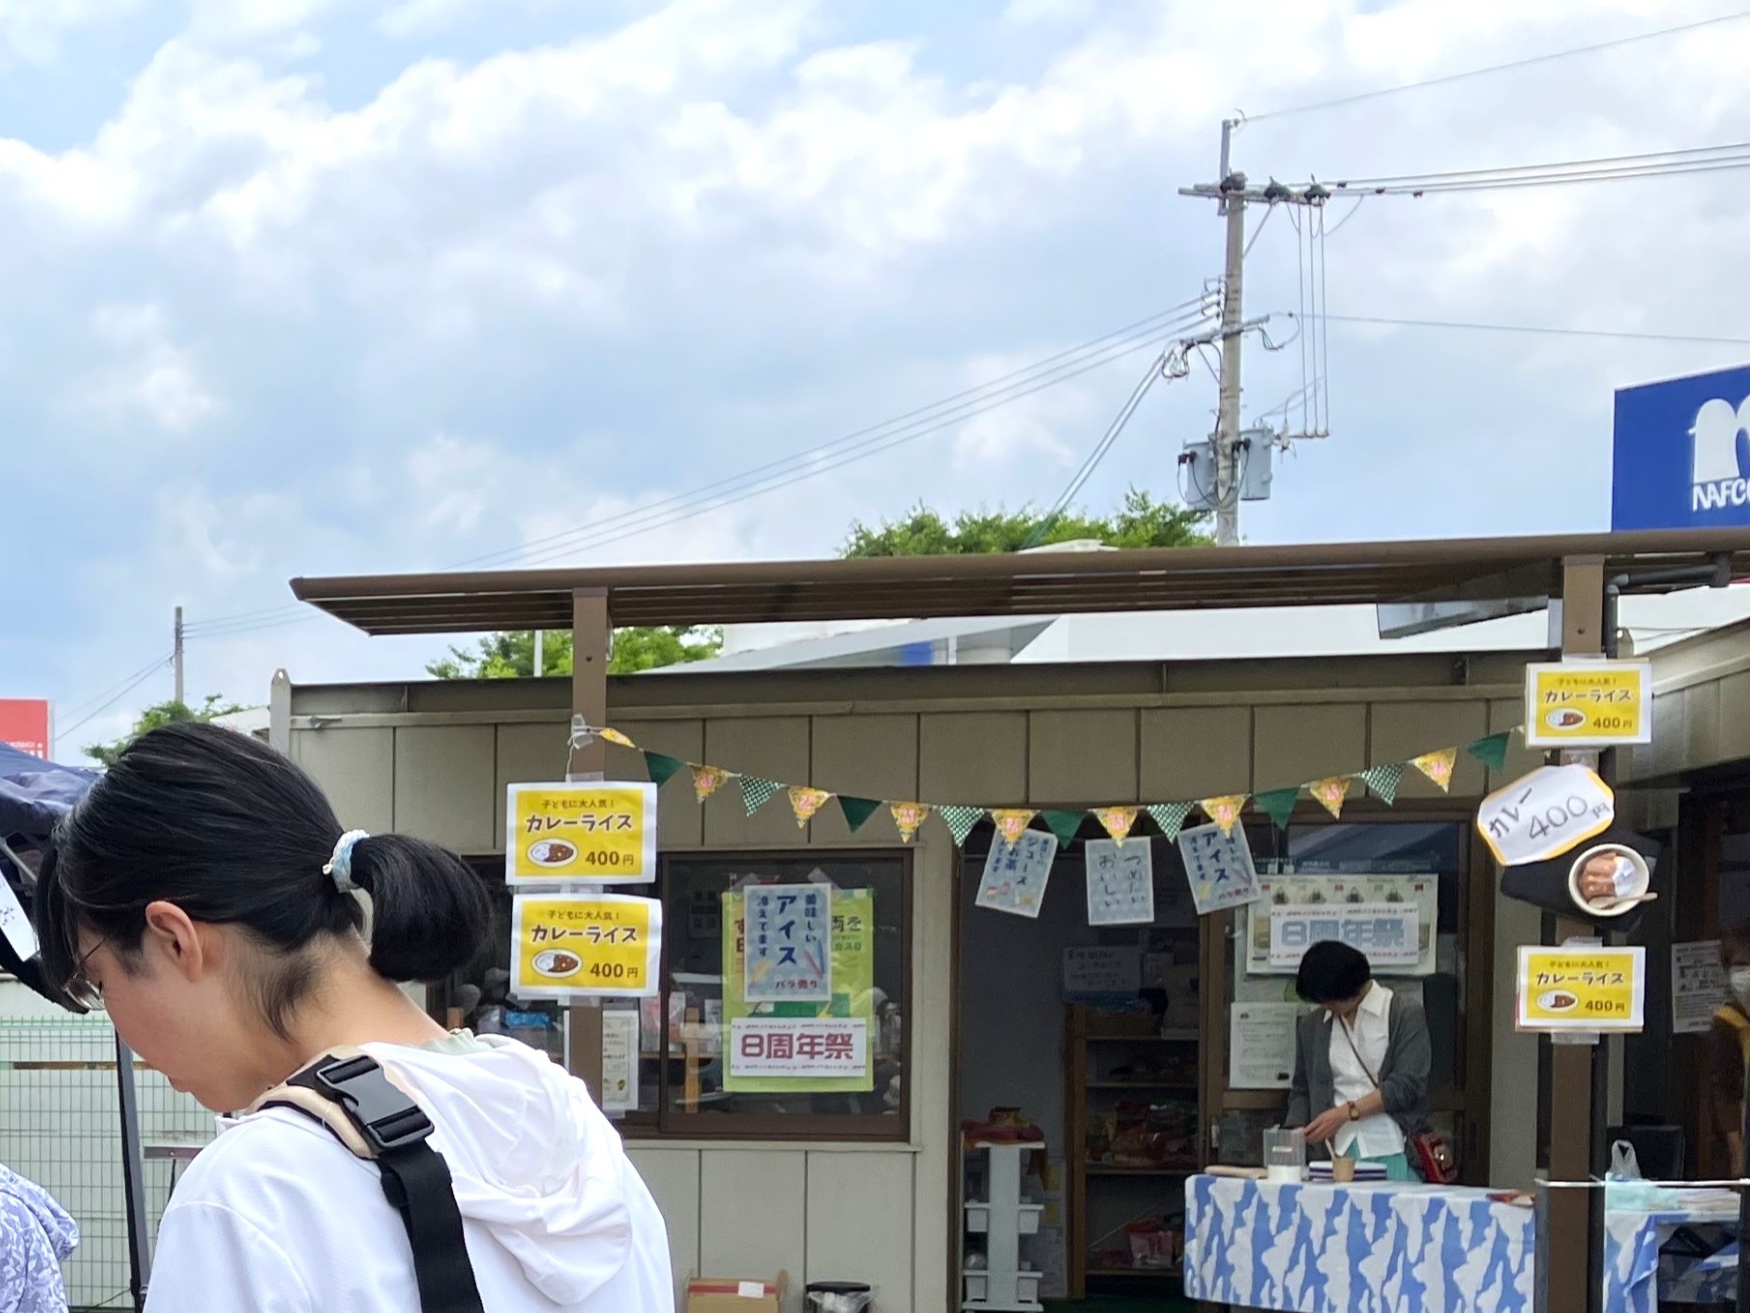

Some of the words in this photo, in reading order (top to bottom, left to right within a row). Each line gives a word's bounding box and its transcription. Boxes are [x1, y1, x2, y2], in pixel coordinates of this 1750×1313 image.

[1693, 478, 1750, 512] NAFC
[1546, 689, 1631, 704] カレーライス
[1490, 788, 1532, 838] カレー
[526, 814, 632, 833] カレーライス
[585, 851, 634, 866] 400円
[1202, 830, 1230, 883] アイス
[531, 925, 637, 944] カレーライス
[776, 895, 797, 966] アイス
[590, 963, 638, 978] 400円
[1537, 972, 1624, 986] カレーライス
[741, 1033, 854, 1060] 8周年祭
